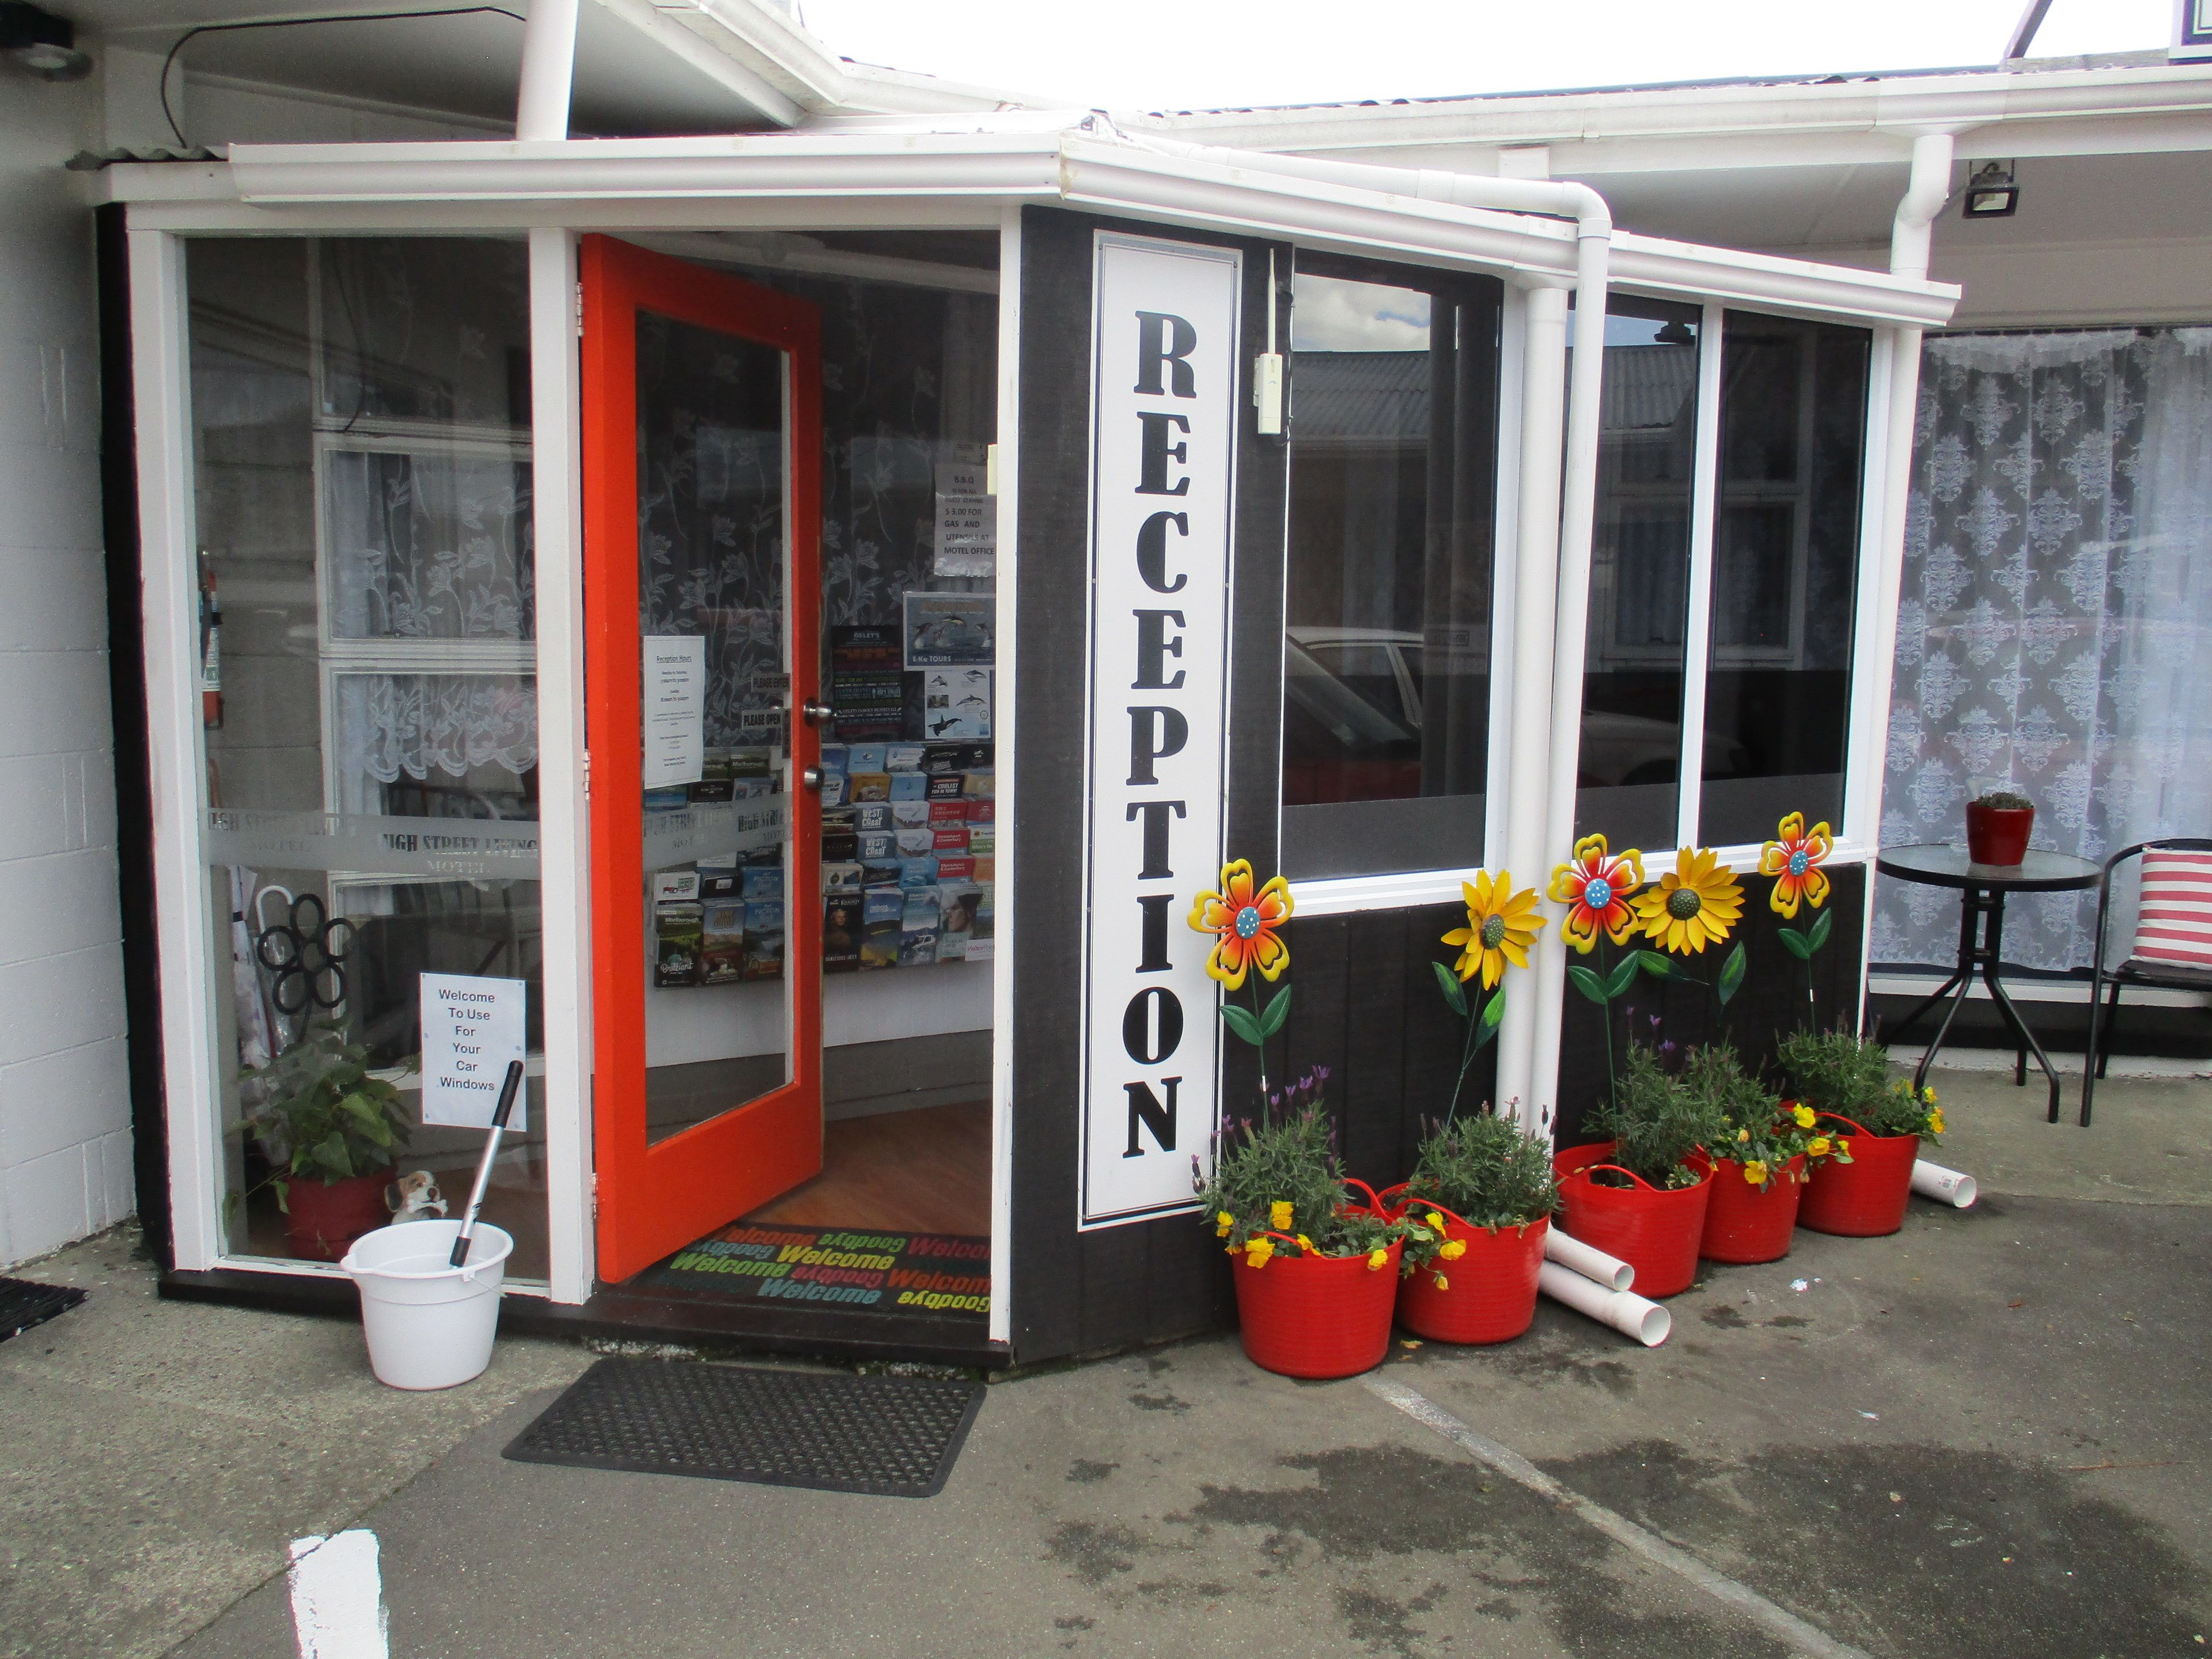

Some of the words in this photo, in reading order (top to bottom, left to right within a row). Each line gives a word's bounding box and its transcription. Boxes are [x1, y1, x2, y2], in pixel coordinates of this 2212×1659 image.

[657, 655, 678, 663] Reception
[754, 677, 772, 688] PLEASE
[744, 714, 765, 726] PLEASE
[767, 713, 781, 725] OPEN
[1123, 309, 1200, 1159] RECEPTION
[439, 988, 495, 1004] Welcome
[448, 1007, 463, 1020] To
[467, 1009, 490, 1021] Use
[455, 1025, 475, 1037] For
[452, 1043, 481, 1056] Your
[456, 1060, 478, 1073] Car
[440, 1077, 495, 1091] Windows
[818, 1232, 907, 1253] Goodbye
[777, 1245, 895, 1270] Welcome
[671, 1252, 793, 1278] Welcome
[791, 1264, 884, 1289] Goodbye
[888, 1268, 991, 1295] Welcom
[757, 1277, 882, 1305] Welcome
